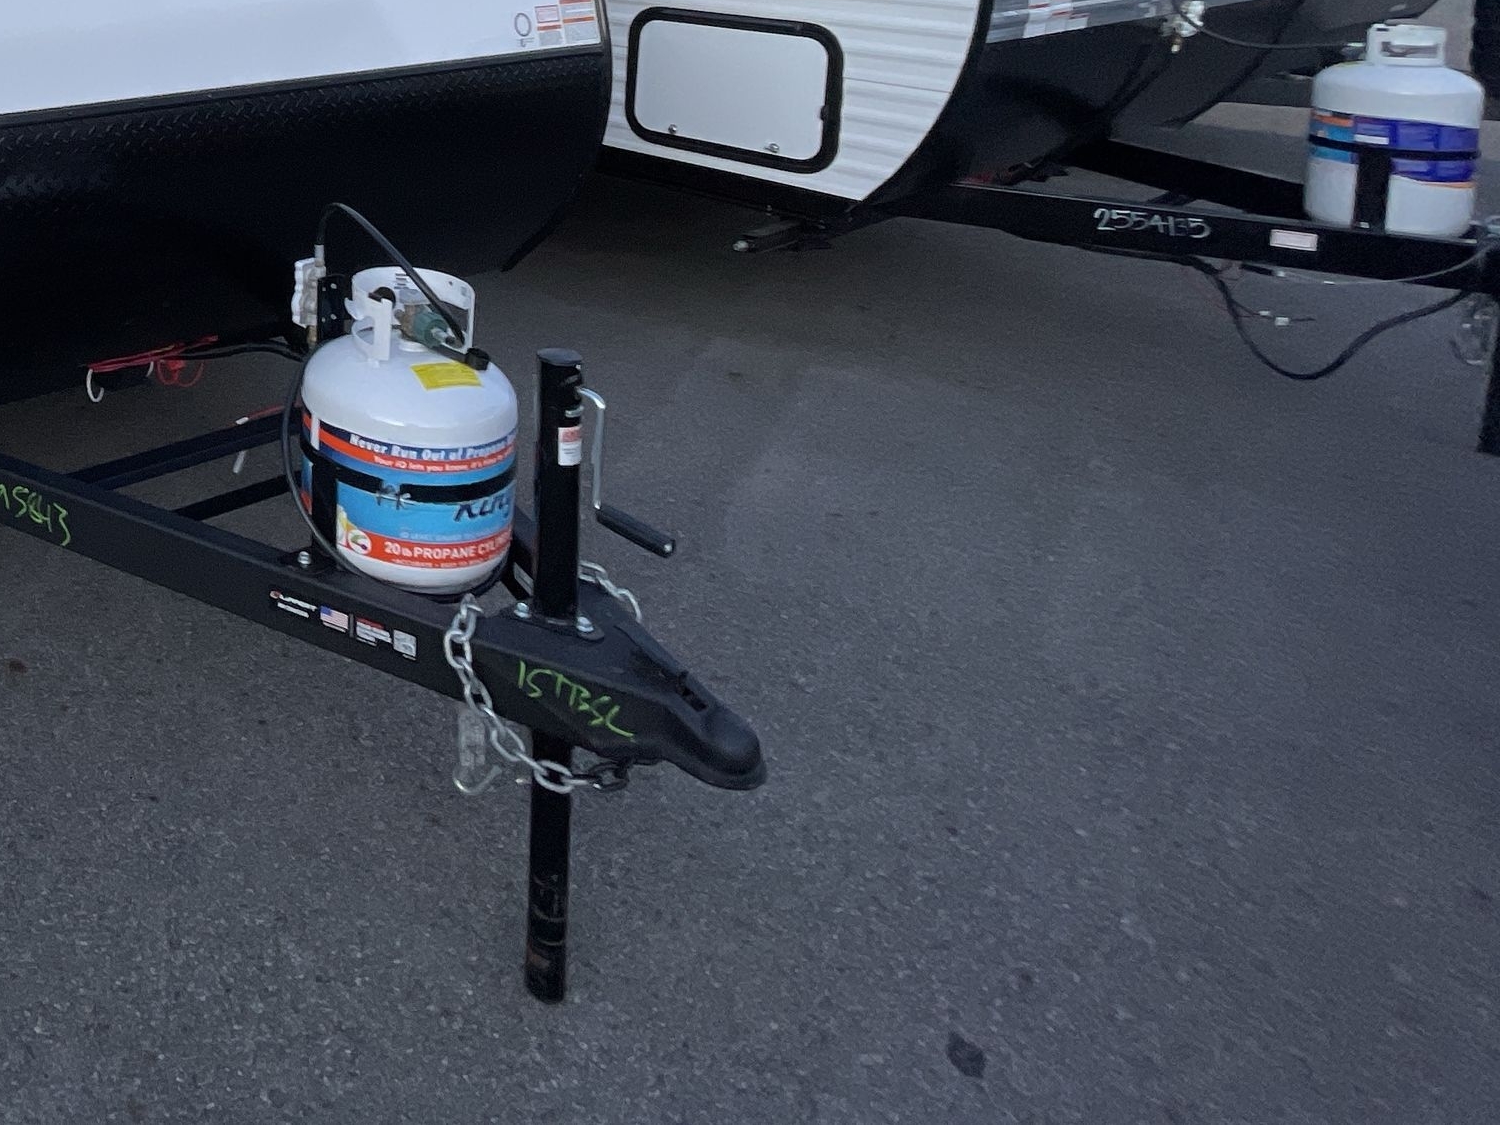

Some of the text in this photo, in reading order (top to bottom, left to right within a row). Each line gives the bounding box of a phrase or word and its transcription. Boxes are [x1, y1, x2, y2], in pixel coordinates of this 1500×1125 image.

[349, 433, 388, 454] Never
[390, 444, 418, 460] Run
[421, 448, 446, 461] Out
[449, 448, 463, 461] of
[413, 545, 478, 560] PROPANE
